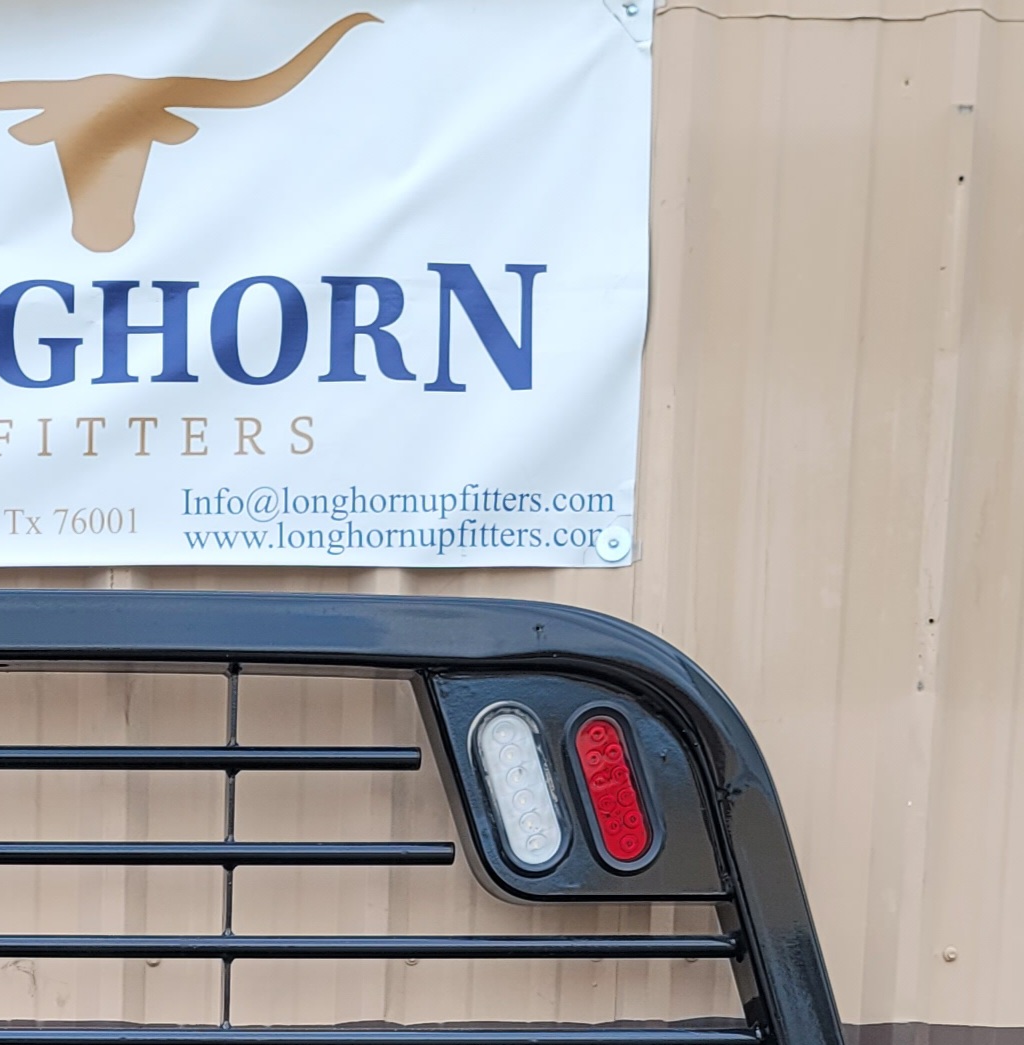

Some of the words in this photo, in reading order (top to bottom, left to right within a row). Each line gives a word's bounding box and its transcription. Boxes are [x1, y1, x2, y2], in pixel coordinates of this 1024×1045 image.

[181, 484, 615, 523] Info@longhornupfitters.com
[2, 508, 42, 535] Tx
[53, 508, 140, 535] 76001
